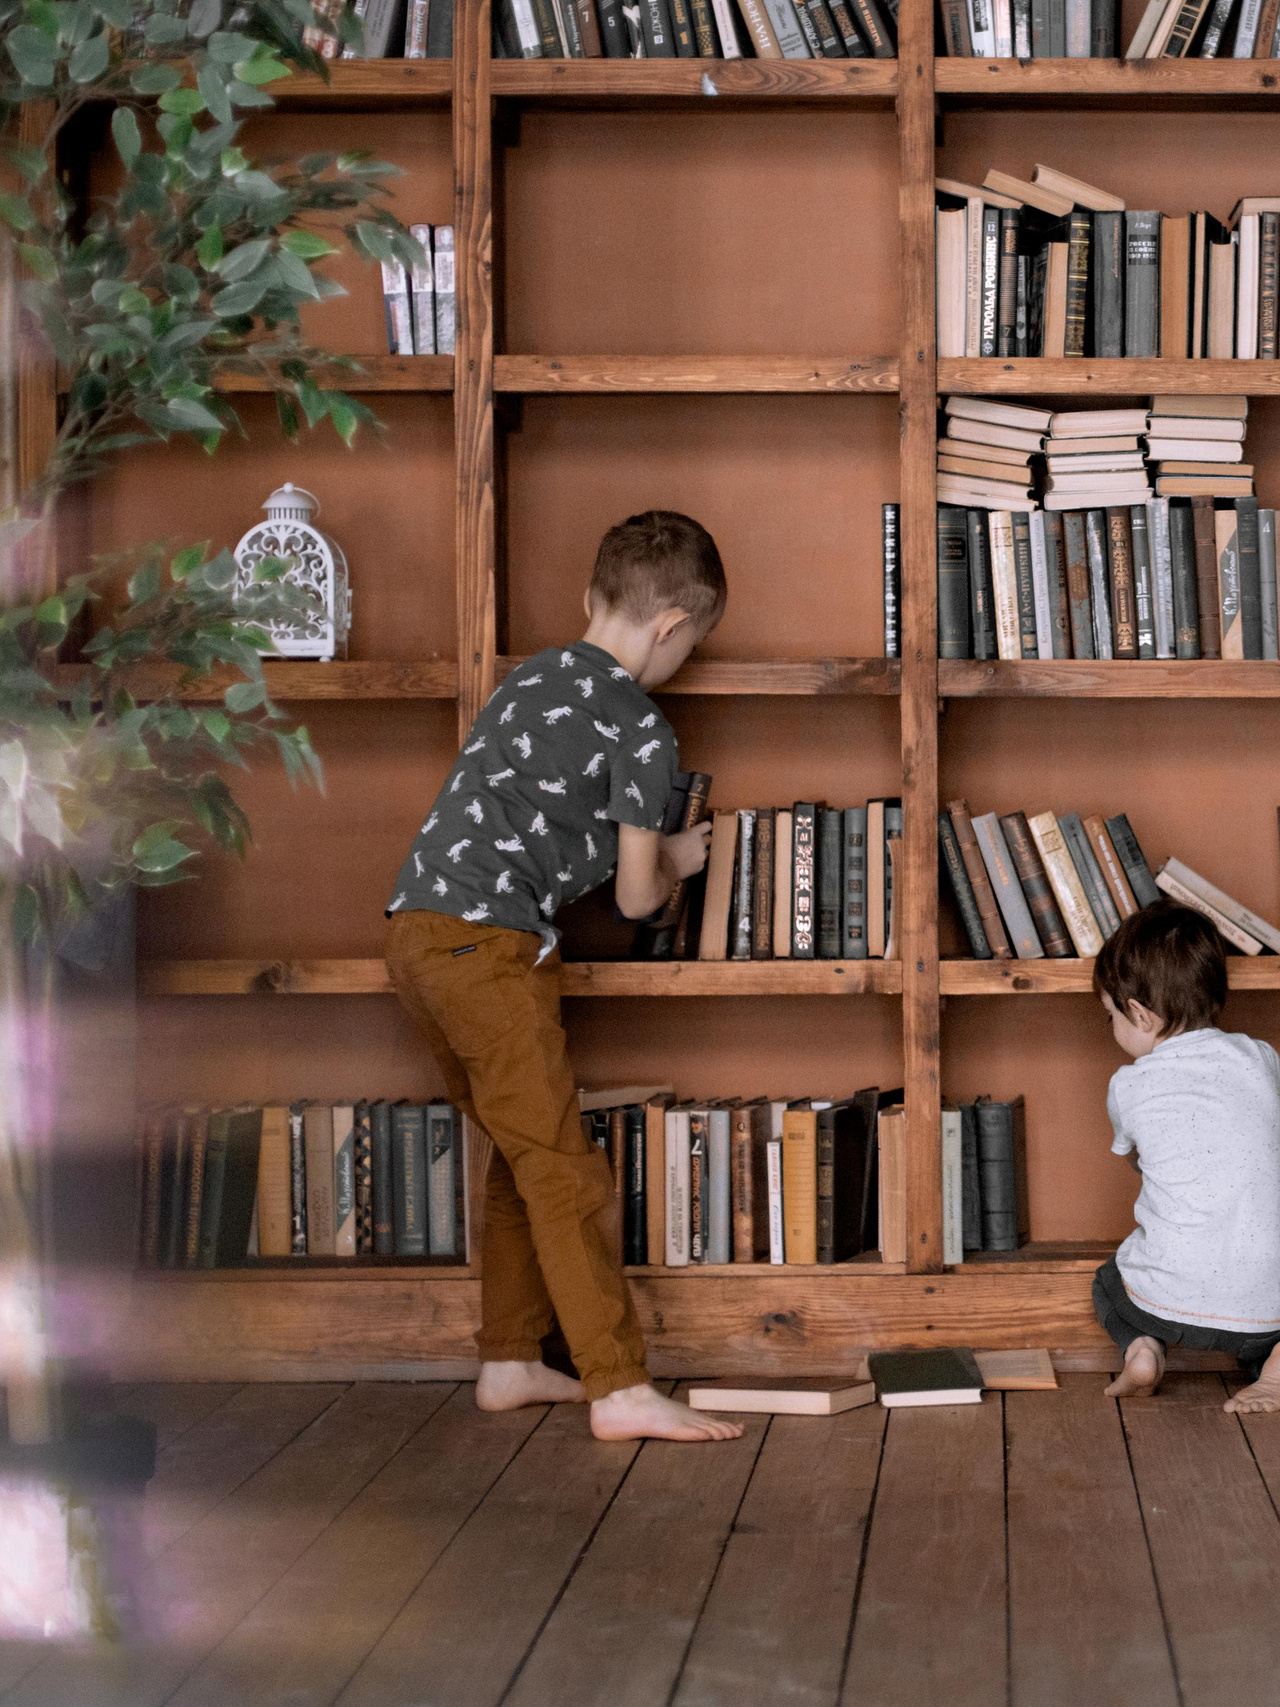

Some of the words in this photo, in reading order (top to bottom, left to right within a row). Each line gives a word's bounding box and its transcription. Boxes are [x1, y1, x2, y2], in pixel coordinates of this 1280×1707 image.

[607, 17, 615, 27] 5
[646, 1, 663, 33] ДЖОН
[985, 235, 997, 289] РОББИНС
[983, 290, 996, 340] ГАРОЛЬД
